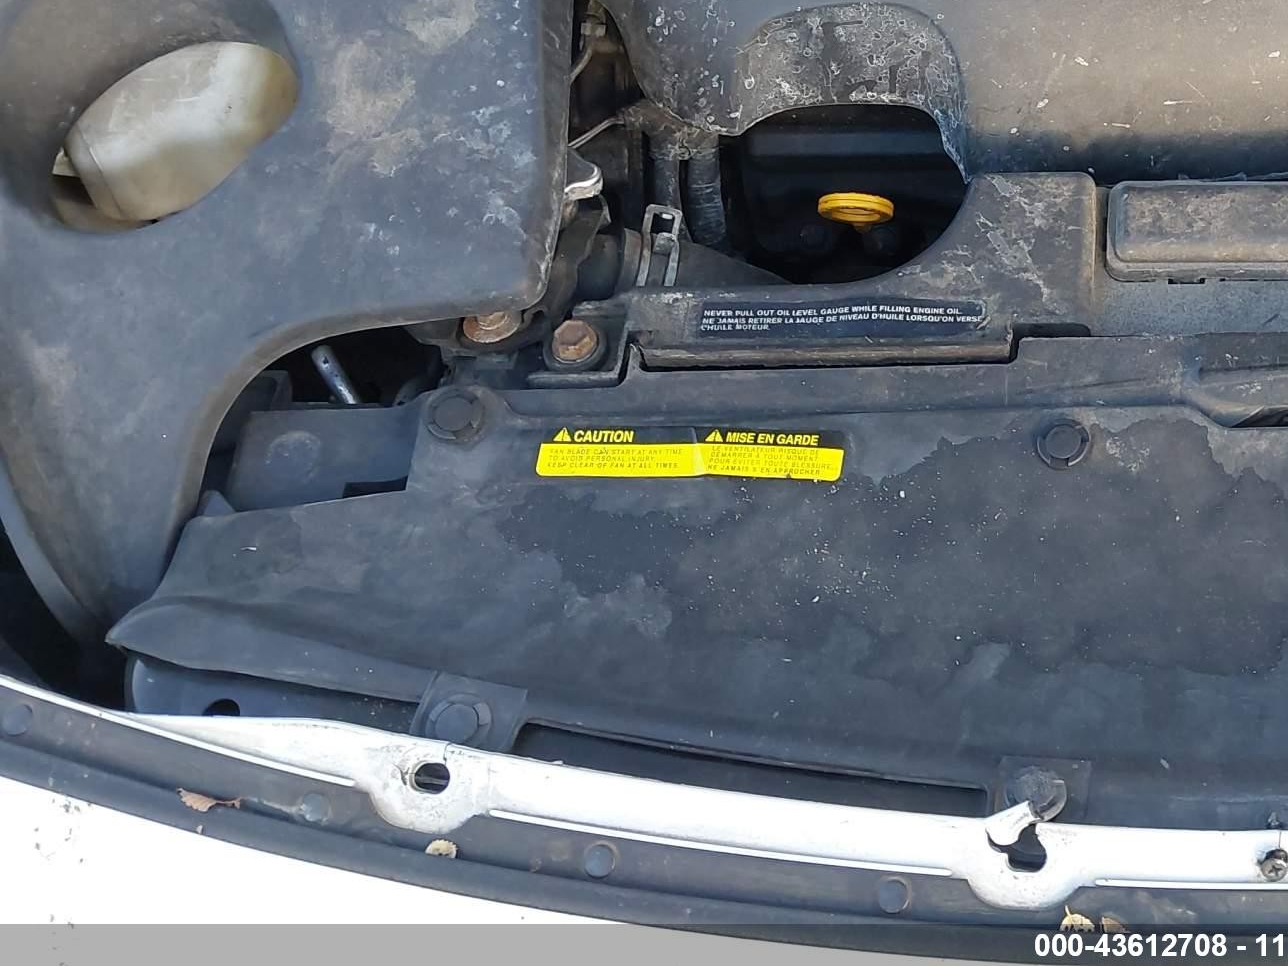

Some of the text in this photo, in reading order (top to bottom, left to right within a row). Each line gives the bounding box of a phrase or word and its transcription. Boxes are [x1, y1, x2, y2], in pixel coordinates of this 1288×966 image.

[821, 306, 850, 315] GAUGE
[795, 316, 824, 324] JAUGE
[574, 430, 634, 443] CAUTION
[726, 432, 820, 446] MISE EN GARDE
